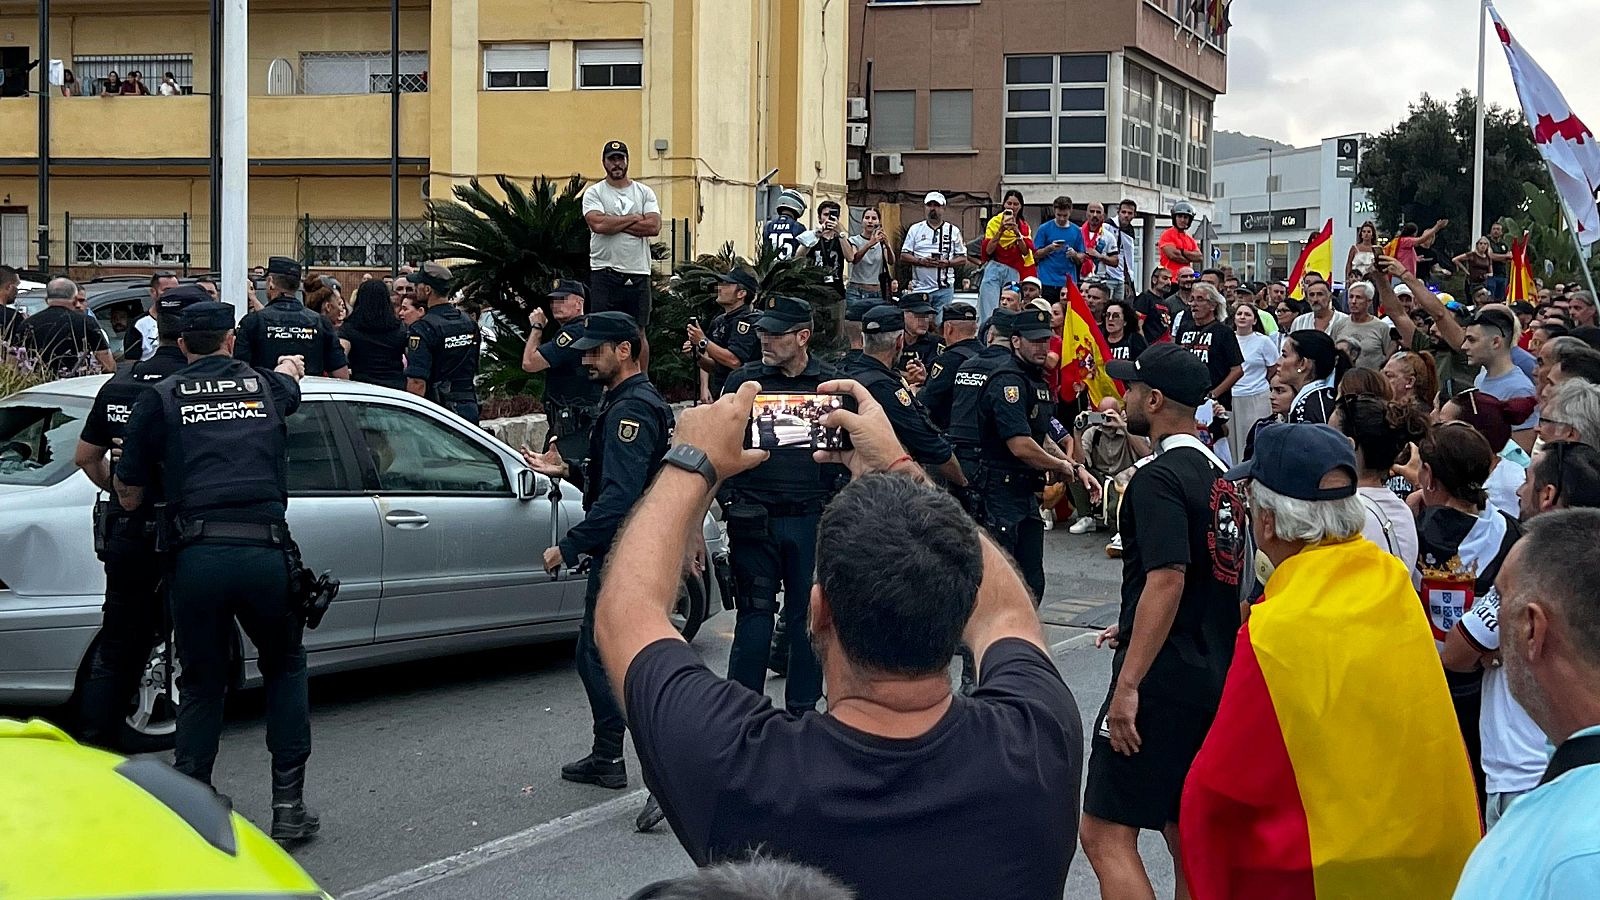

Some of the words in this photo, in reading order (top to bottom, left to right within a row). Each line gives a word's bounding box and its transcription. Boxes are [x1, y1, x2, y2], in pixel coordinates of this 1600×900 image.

[769, 233, 793, 260] 15
[956, 372, 987, 381] POLICIA
[180, 380, 243, 395] U.I.P.
[181, 402, 248, 415] POLICIA
[182, 409, 267, 425] NACIONAL
